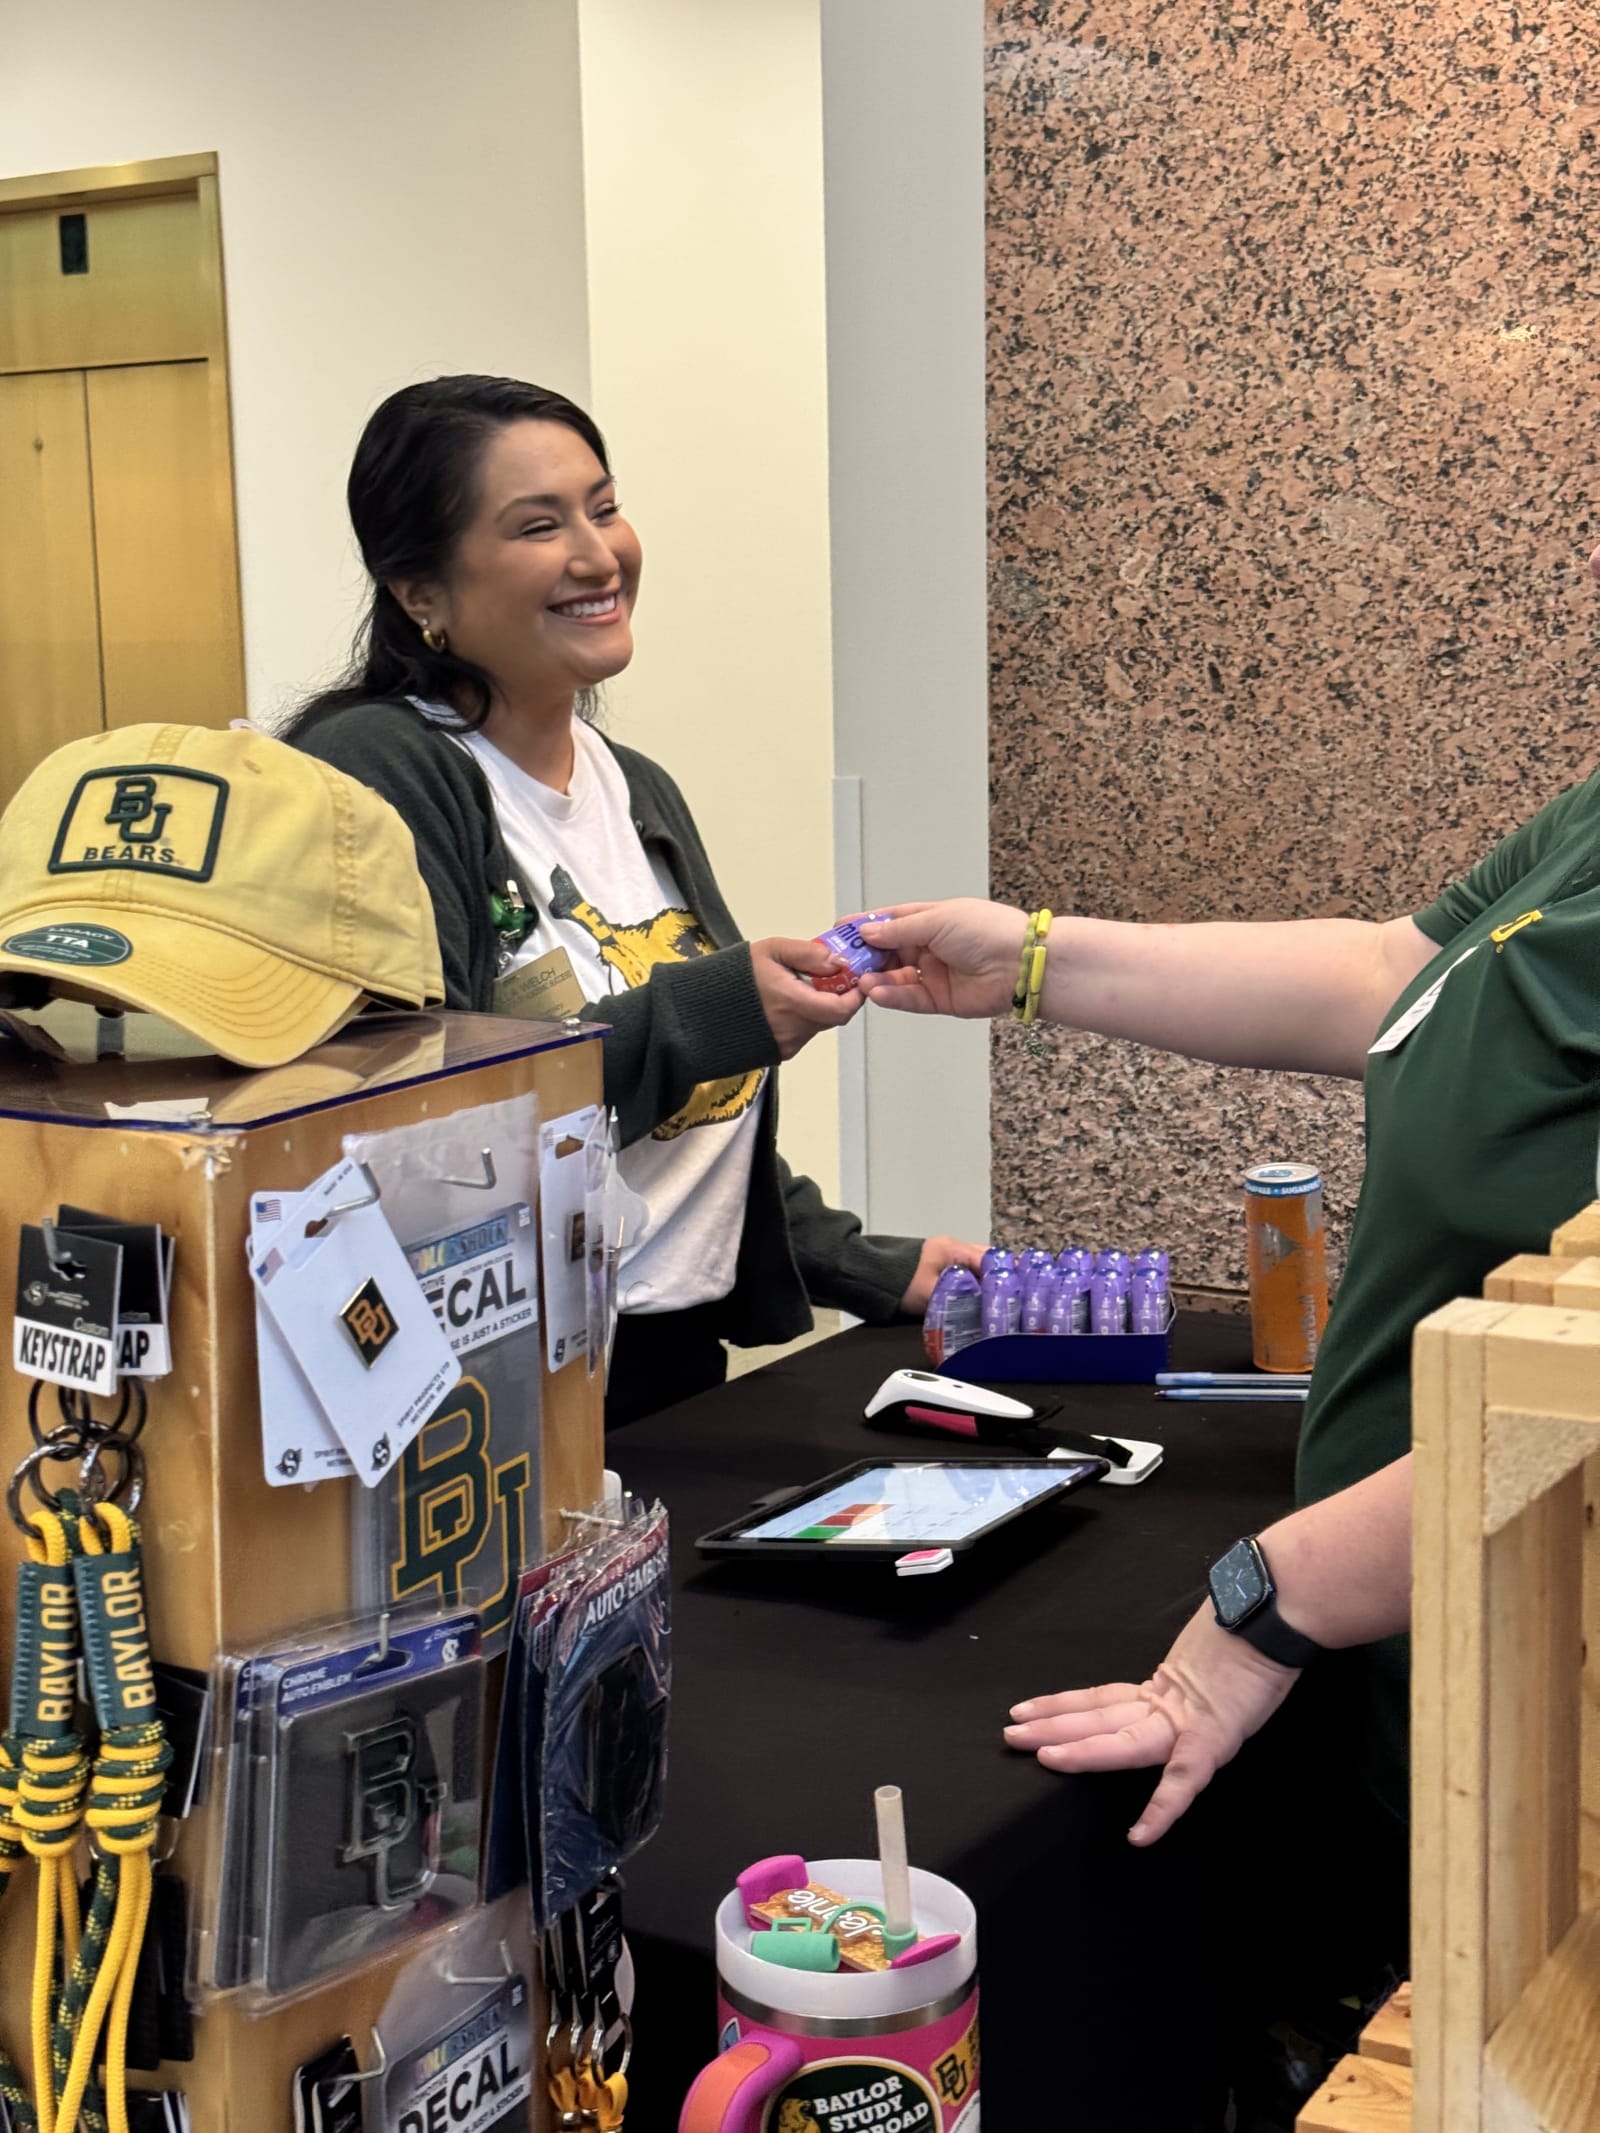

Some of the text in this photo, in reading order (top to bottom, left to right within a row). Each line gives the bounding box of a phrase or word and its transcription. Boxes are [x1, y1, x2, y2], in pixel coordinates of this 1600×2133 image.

[104, 776, 173, 843] BU
[83, 844, 176, 864] BEARS
[46, 934, 90, 950] TTA
[347, 1298, 390, 1345] BU
[471, 1325, 491, 1342] JUST
[492, 1321, 499, 1332] A
[500, 1307, 532, 1330] STICKER
[19, 1325, 106, 1382] KEYSTRAP
[116, 1329, 151, 1369] AP
[584, 1583, 626, 1626] AUTO
[37, 1582, 75, 1723] BAYLOR
[102, 1567, 158, 1710] BAYLOR
[281, 1666, 328, 1690] CHROME
[281, 1671, 353, 1704] AUTO EMBLEM
[813, 2075, 903, 2116] BAYLOR
[935, 2053, 968, 2101] BU
[829, 2094, 903, 2133] STUDY
